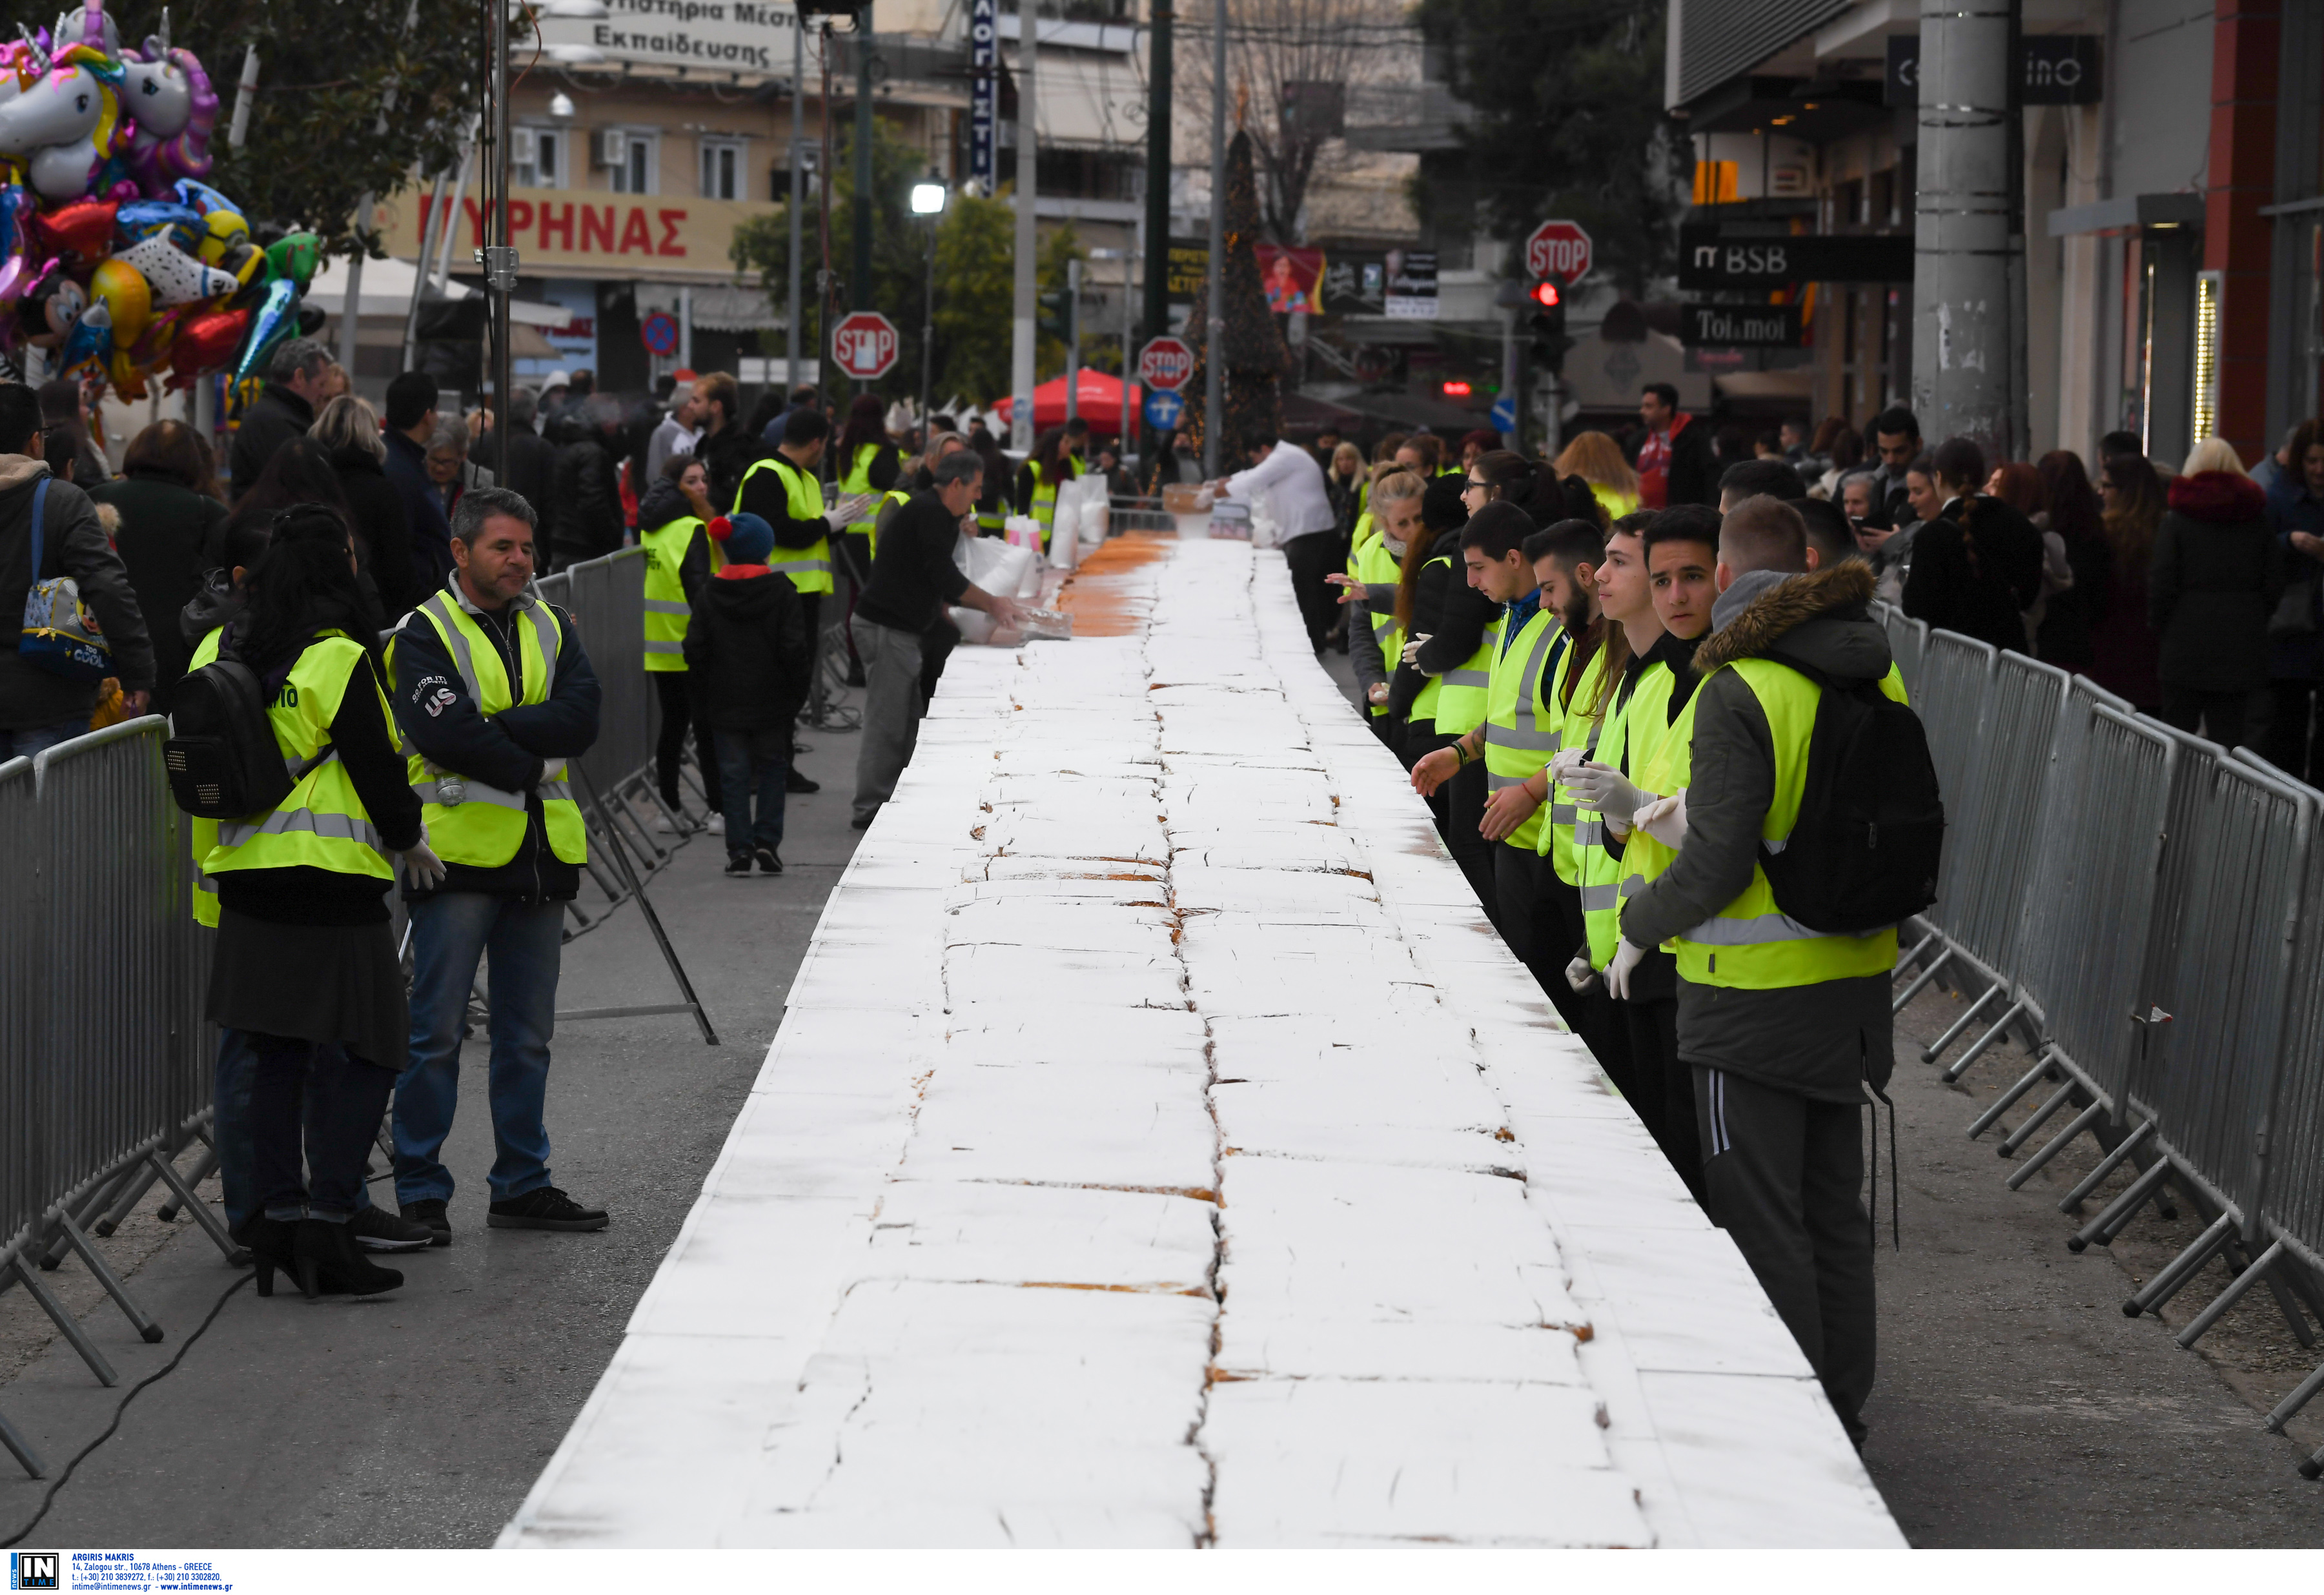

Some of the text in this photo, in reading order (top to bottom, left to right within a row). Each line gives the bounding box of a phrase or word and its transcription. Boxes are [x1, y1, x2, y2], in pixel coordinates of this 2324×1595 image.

[595, 25, 770, 65] Εκπαίδευσης
[1533, 239, 1585, 271] STOP
[1726, 246, 1787, 274] BSB
[1145, 352, 1188, 379] STOP
[74, 649, 105, 669] COOL
[85, 644, 97, 655] TOO
[417, 676, 433, 689] FOR
[425, 687, 456, 717] US
